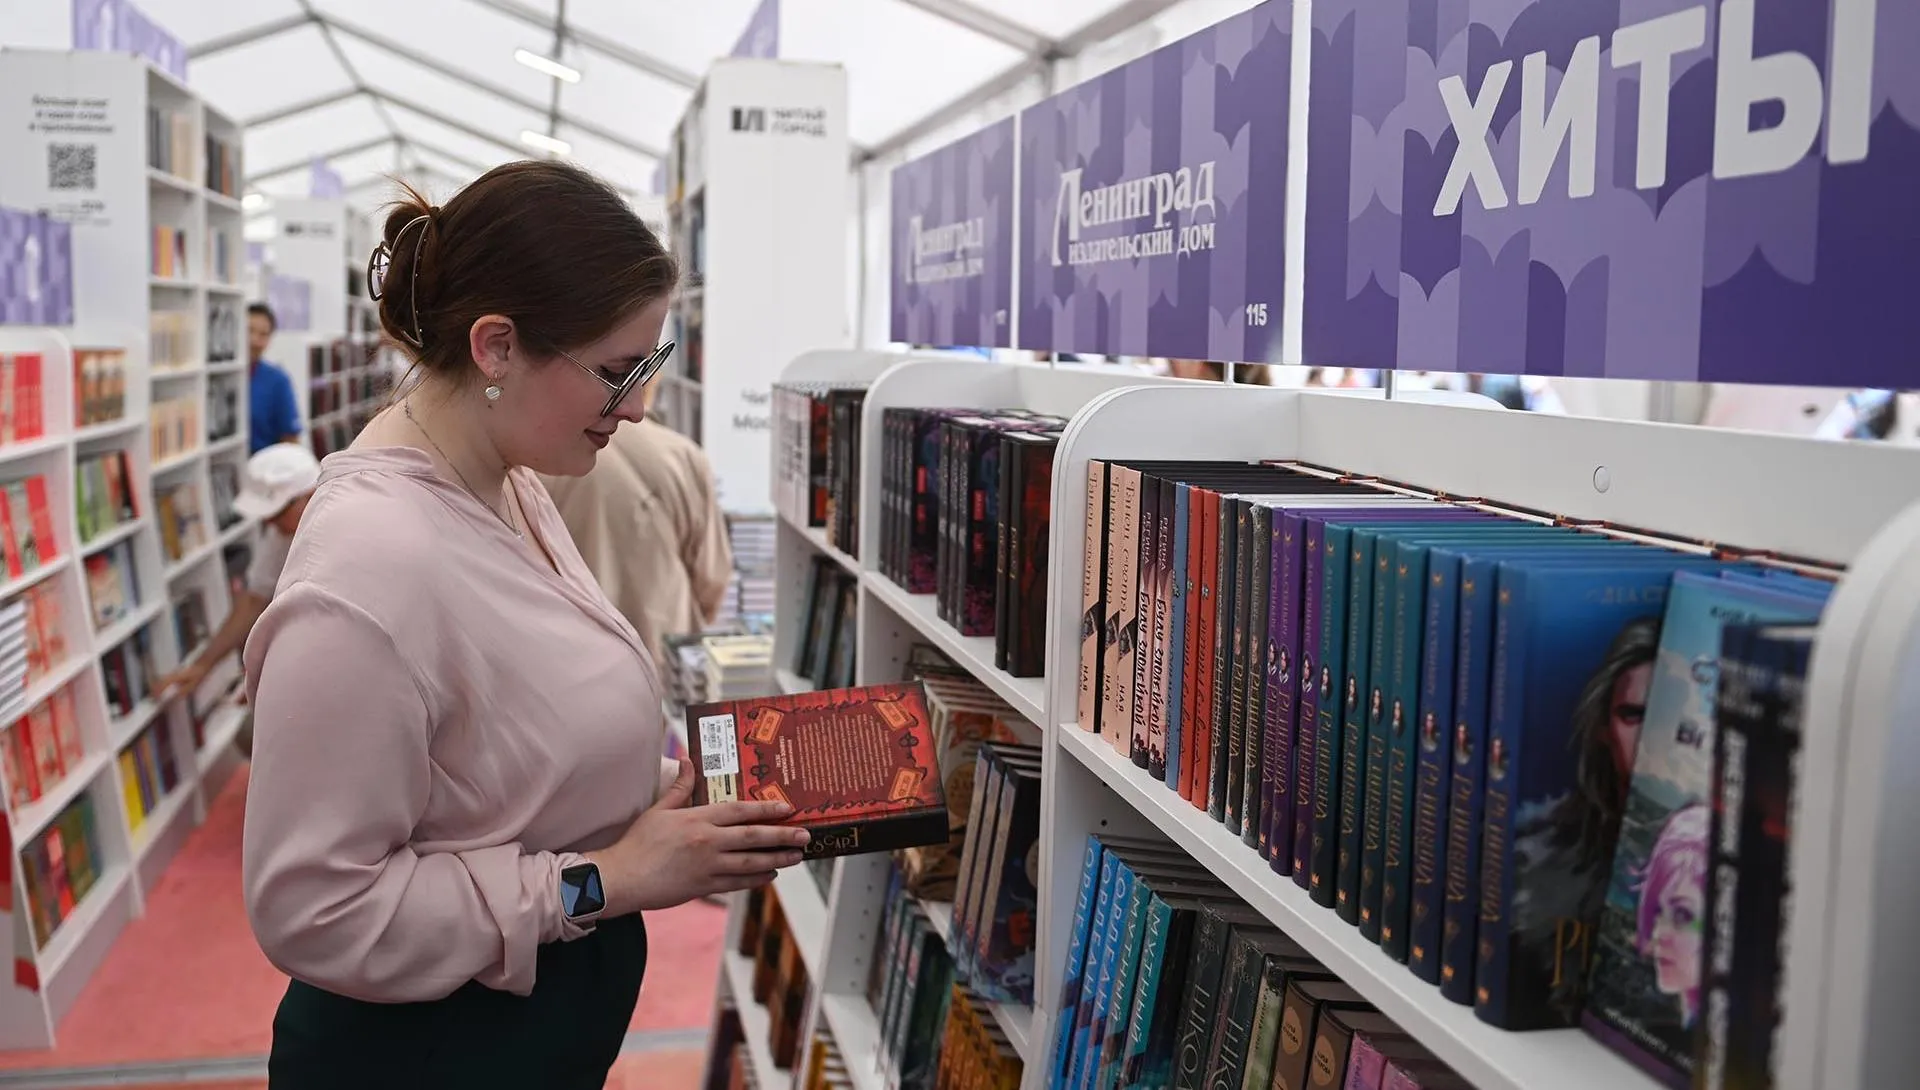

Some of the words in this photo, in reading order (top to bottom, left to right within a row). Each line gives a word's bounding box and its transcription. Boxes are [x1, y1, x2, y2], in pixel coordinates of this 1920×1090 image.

[1433, 0, 1876, 217] ХИТЫ
[1051, 161, 1216, 267] Ленинград
[1068, 222, 1173, 266] издательский
[1176, 223, 1216, 263] дом
[1246, 303, 1268, 327] 115
[1067, 847, 1094, 976] ОРЛЕАН
[1084, 863, 1113, 995] ОРЛЕАН
[1096, 876, 1127, 1012] ОРЛЕАН
[1111, 895, 1141, 1022] МУТНЫЙ
[1132, 911, 1161, 1043] МУТНЫЙ
